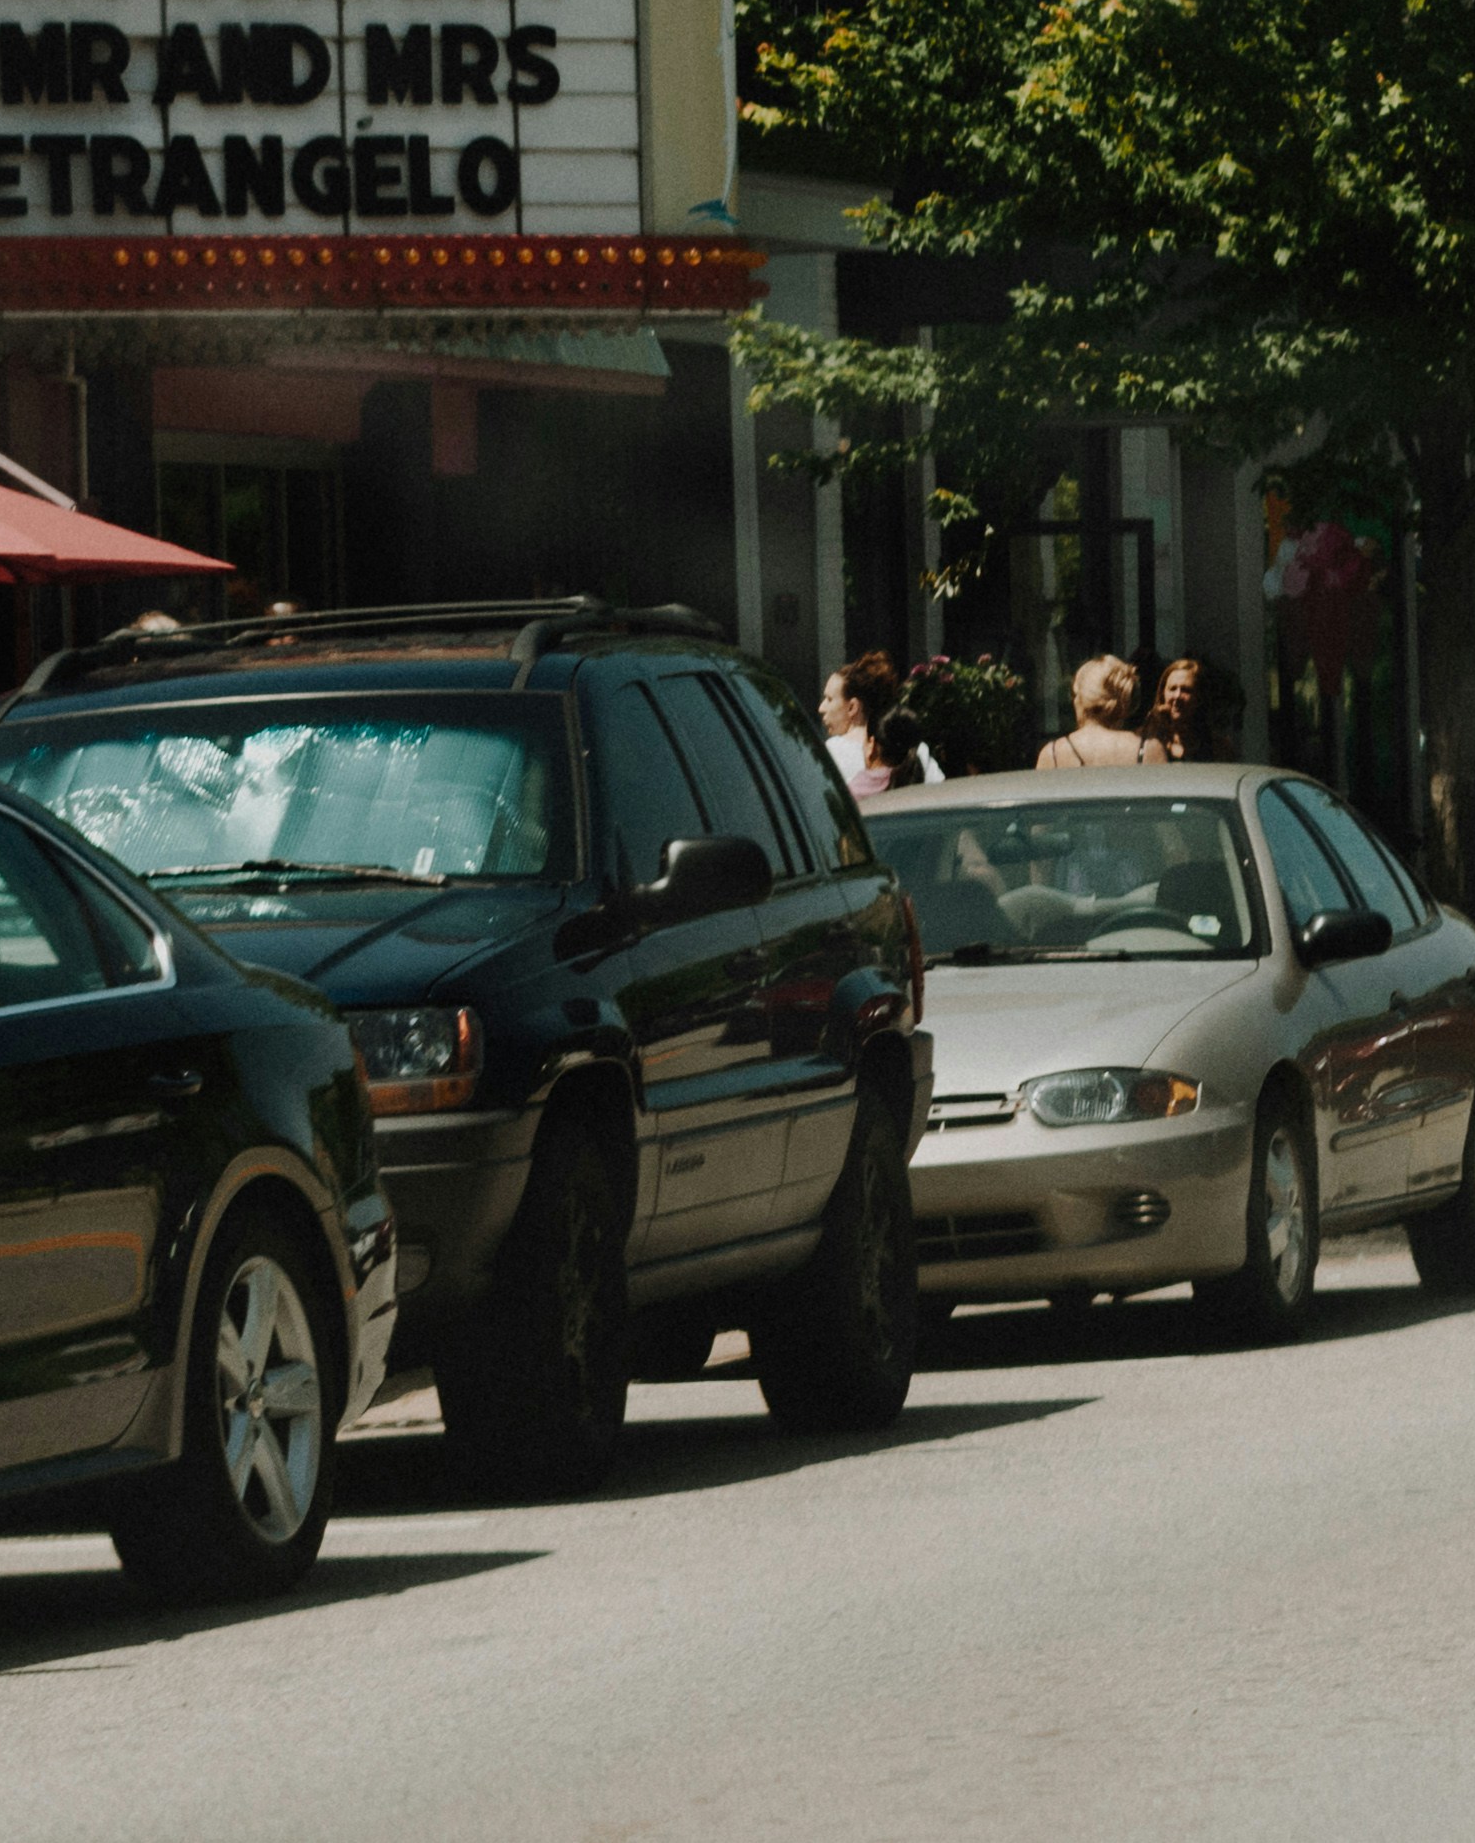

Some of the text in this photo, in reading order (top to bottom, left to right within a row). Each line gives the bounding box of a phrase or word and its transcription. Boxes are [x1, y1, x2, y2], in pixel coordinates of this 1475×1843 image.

[0, 22, 131, 106] MR
[152, 22, 331, 108] AND
[365, 23, 563, 107] MRS
